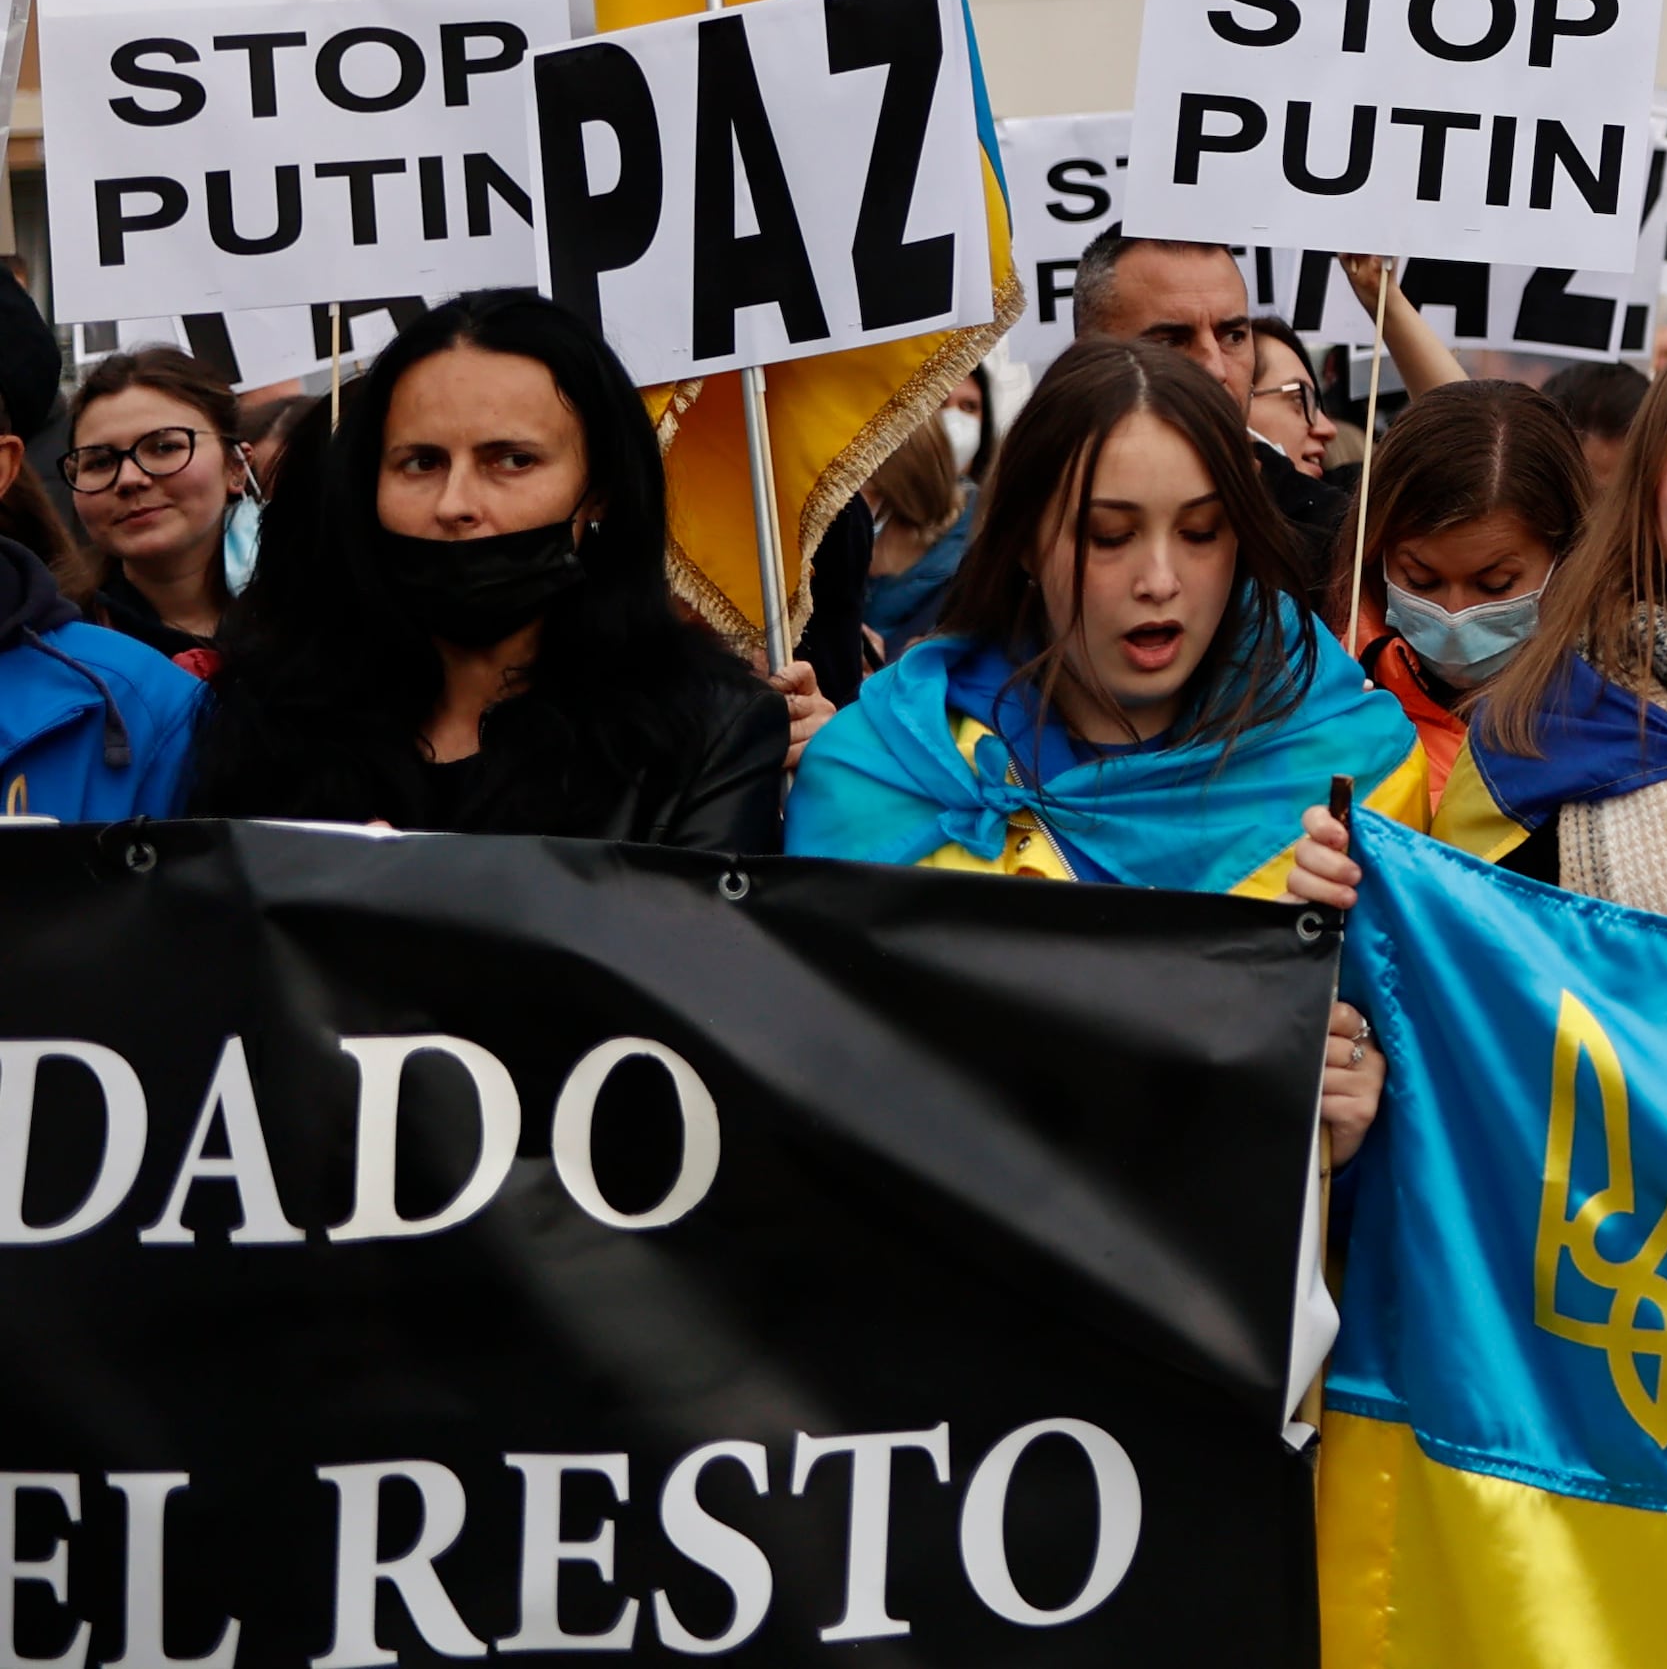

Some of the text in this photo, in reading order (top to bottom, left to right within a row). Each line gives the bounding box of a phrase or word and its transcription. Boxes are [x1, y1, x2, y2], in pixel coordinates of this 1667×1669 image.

[108, 20, 527, 127] STOP
[94, 151, 535, 267] PUTIN
[1172, 92, 1626, 215] PUTIN
[0, 1034, 720, 1245] DADO
[0, 1417, 1142, 1669] EL RESTO
